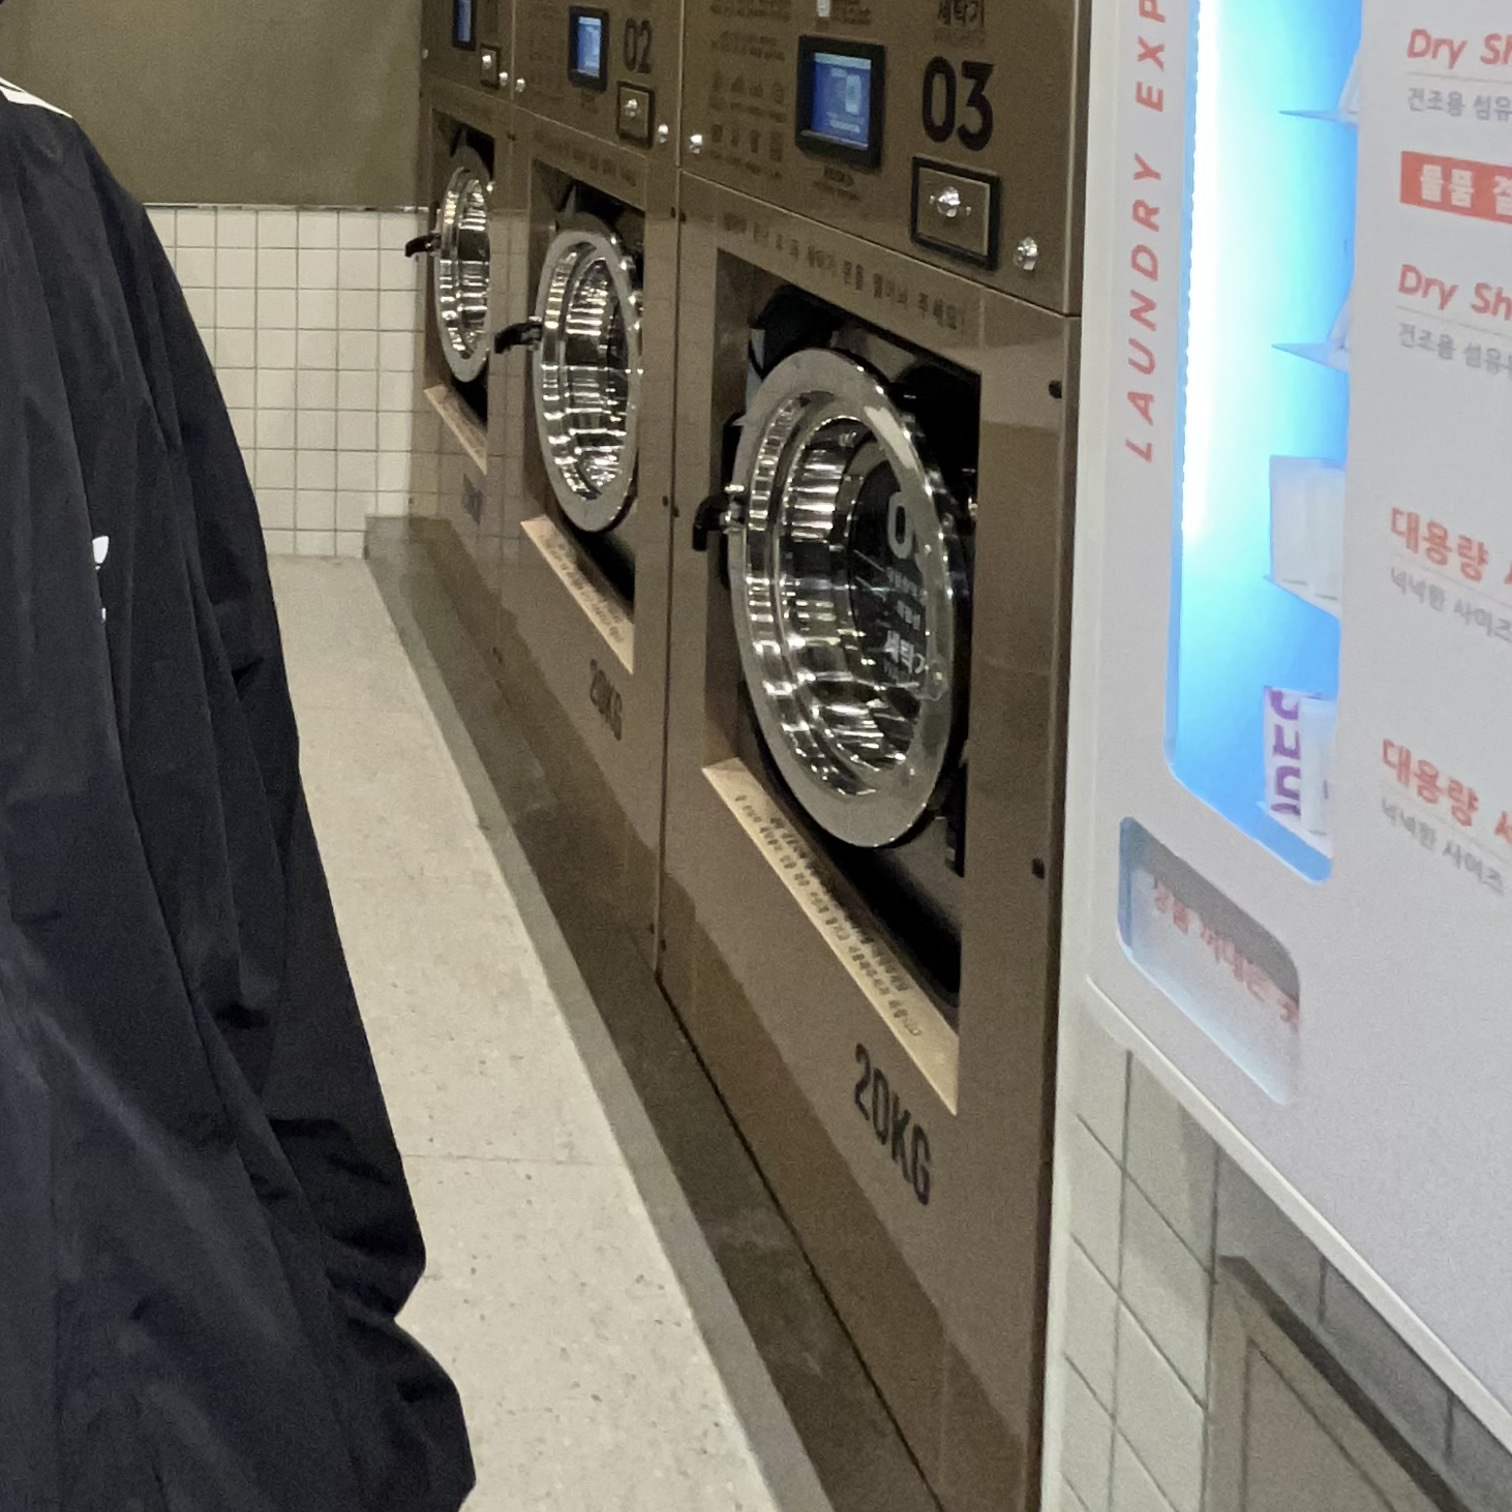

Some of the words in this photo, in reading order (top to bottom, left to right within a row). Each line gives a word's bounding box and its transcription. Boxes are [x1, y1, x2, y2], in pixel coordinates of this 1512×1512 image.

[624, 18, 652, 74] 02
[1406, 28, 1468, 70] Dry
[922, 56, 995, 152] 03
[1407, 87, 1466, 118] 건조용
[1124, 152, 1162, 464] LAUNDRY
[1399, 263, 1460, 311] Dry
[1391, 506, 1489, 585] 대용량
[589, 658, 623, 742] 20KG
[1382, 738, 1479, 828] 대용량
[854, 1042, 931, 1206] 20KG
